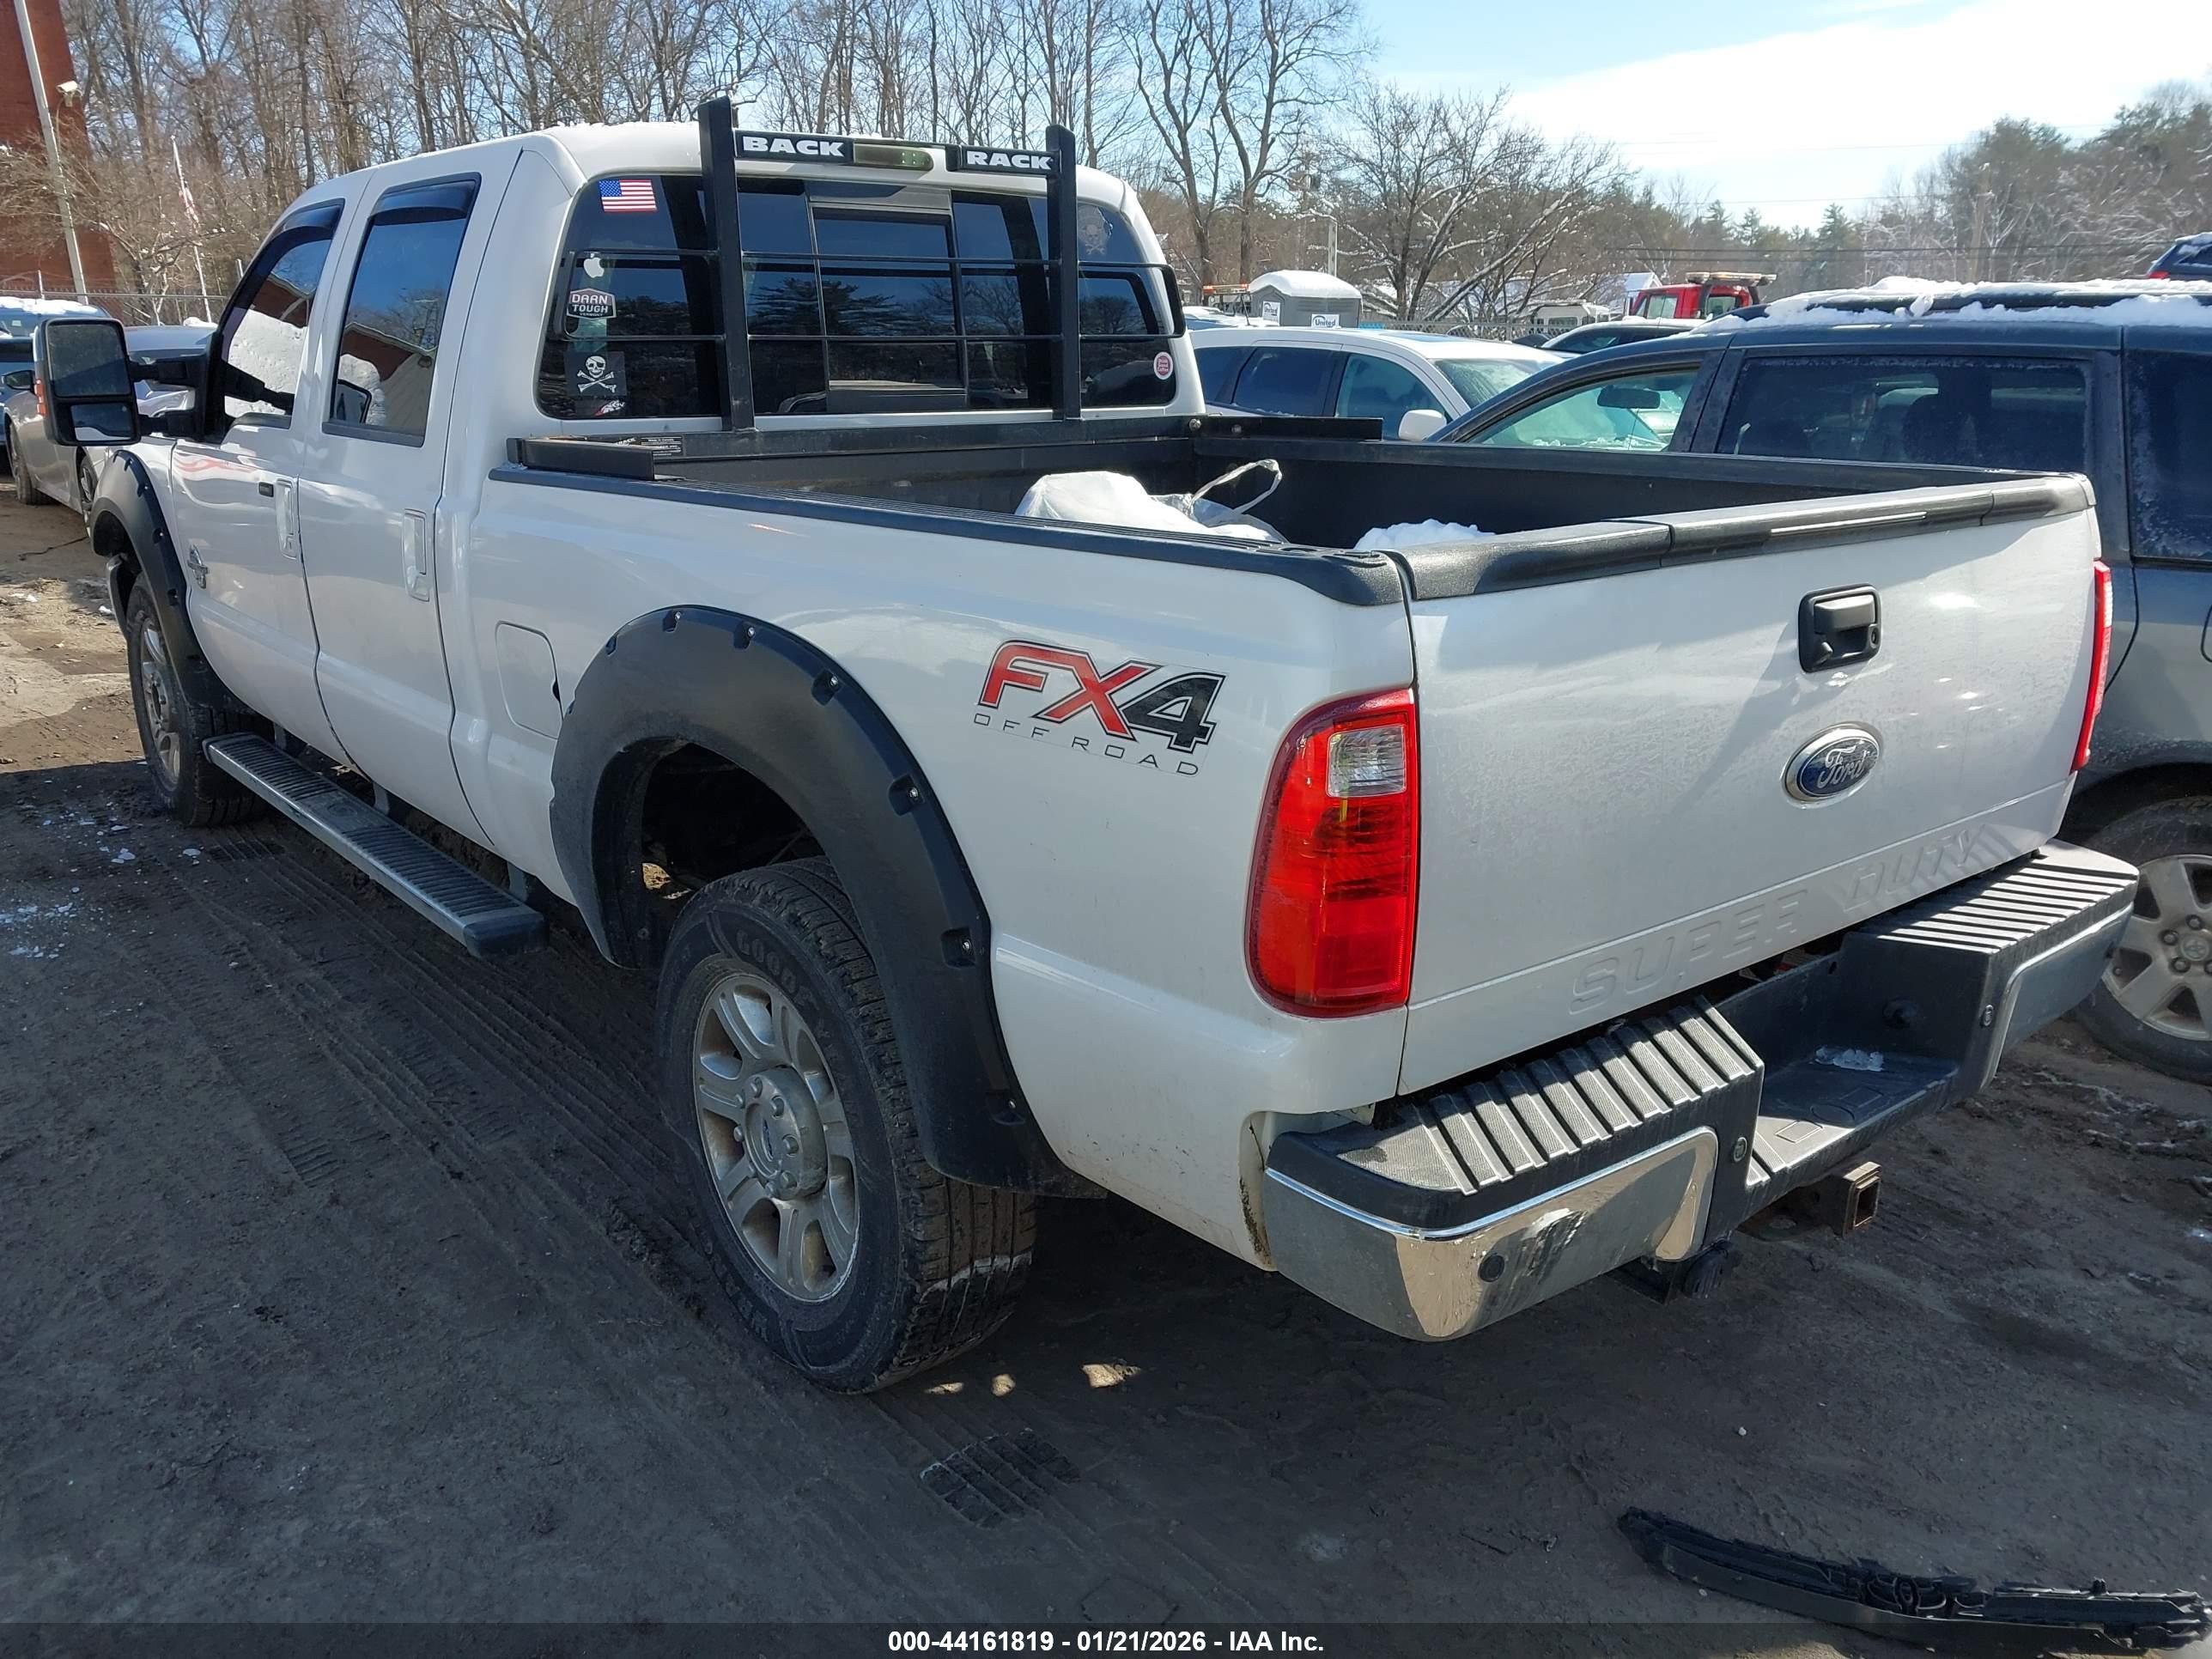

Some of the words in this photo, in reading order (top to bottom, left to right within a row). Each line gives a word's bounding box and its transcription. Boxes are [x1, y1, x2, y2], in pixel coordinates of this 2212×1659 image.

[742, 136, 844, 157] BACK
[966, 149, 1053, 170] RACK
[571, 294, 608, 305] DARN
[572, 304, 609, 313] TOUGH
[977, 639, 1227, 755] FX4
[1816, 744, 1870, 789] Ford
[1569, 888, 1808, 1016] SUPER
[1843, 823, 1987, 913] DUTY
